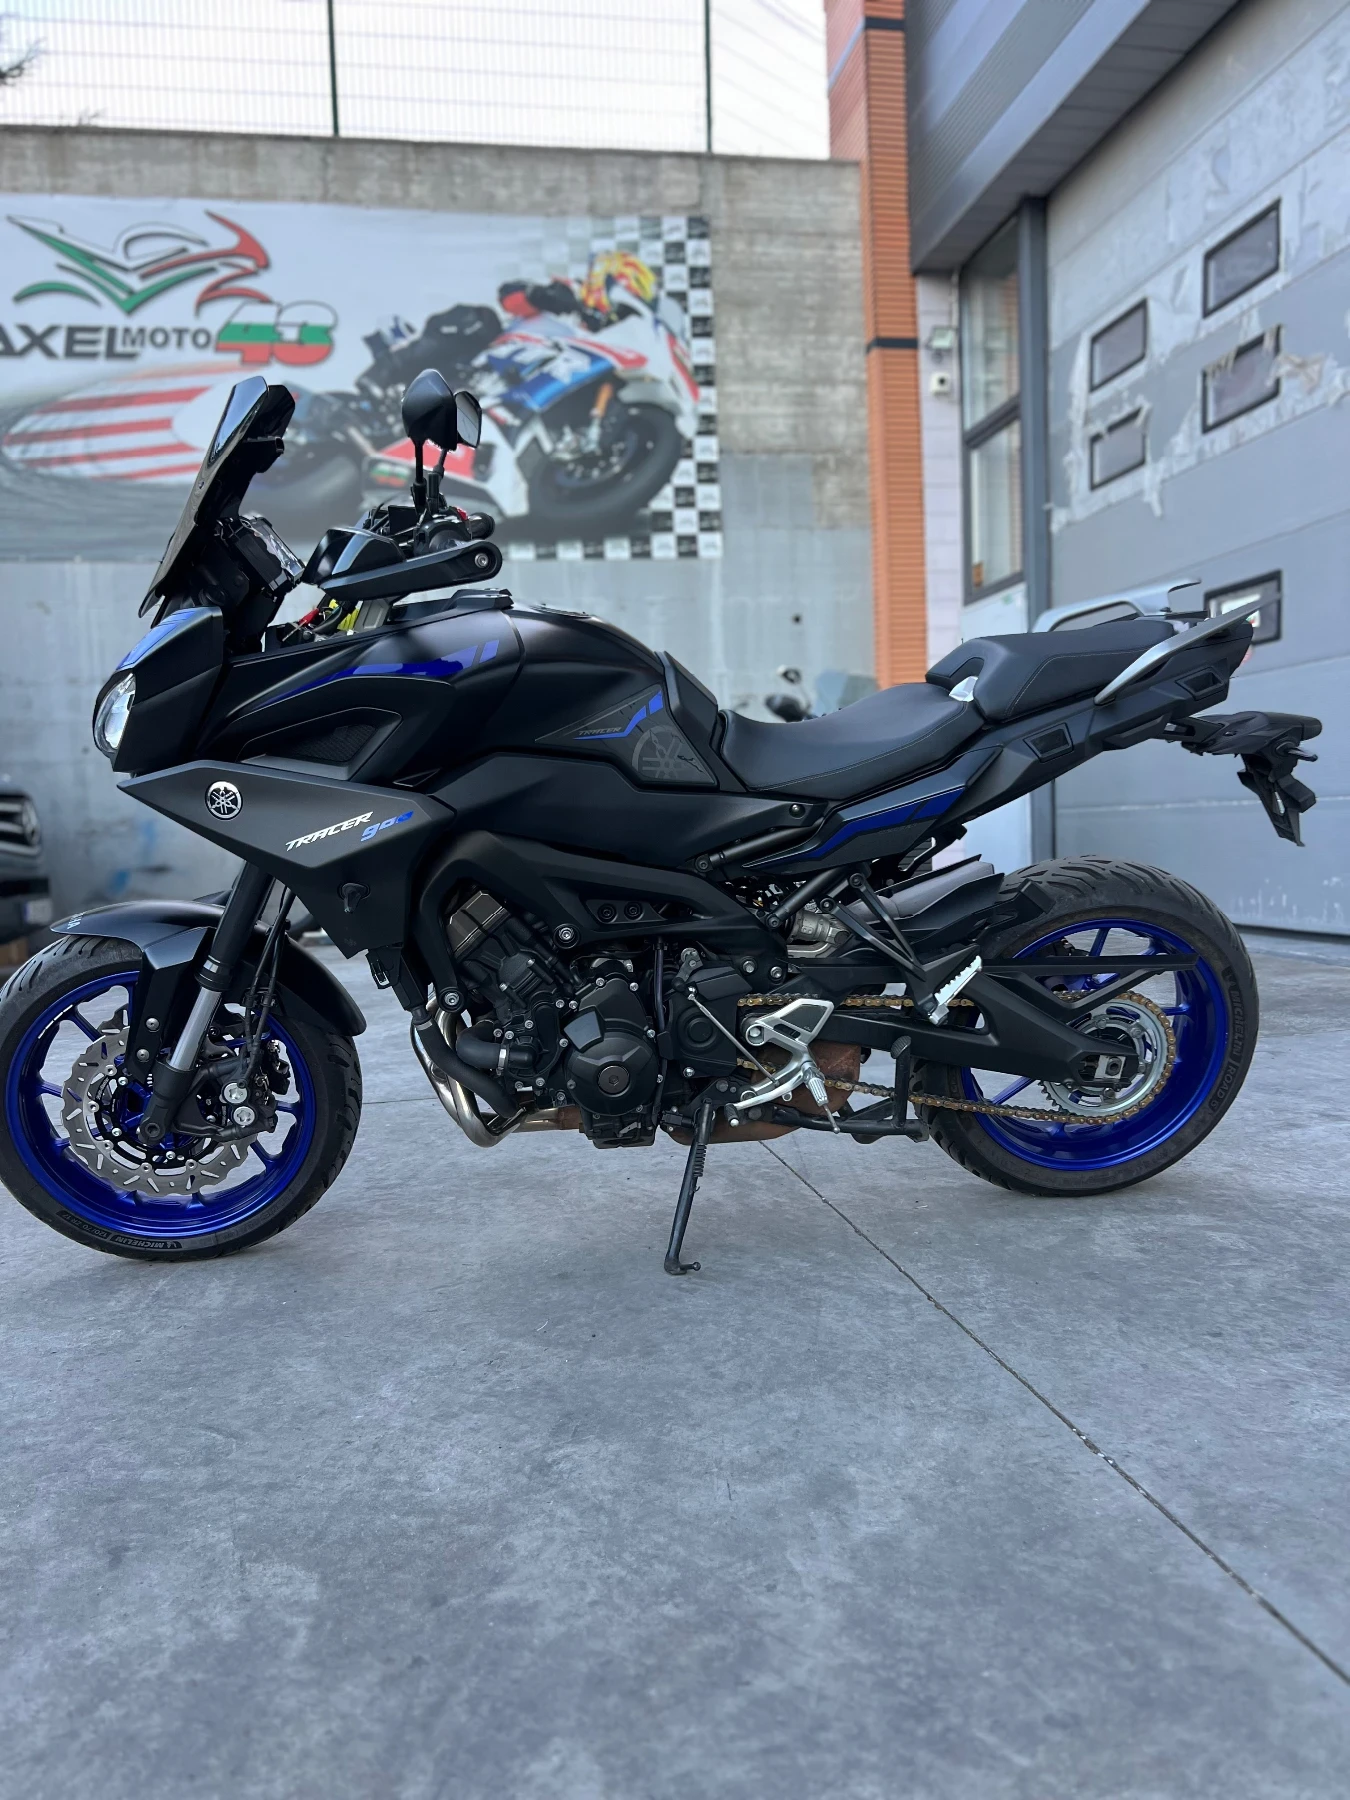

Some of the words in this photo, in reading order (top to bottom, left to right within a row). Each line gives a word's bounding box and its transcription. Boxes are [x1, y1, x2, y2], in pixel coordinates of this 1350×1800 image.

[122, 326, 212, 349] MOTO
[285, 811, 373, 851] TRACER
[360, 811, 414, 842] 900
[1230, 990, 1244, 1055] MICHELIN
[1217, 1065, 1237, 1099] ROAD
[115, 1236, 165, 1249] MICHELIN
